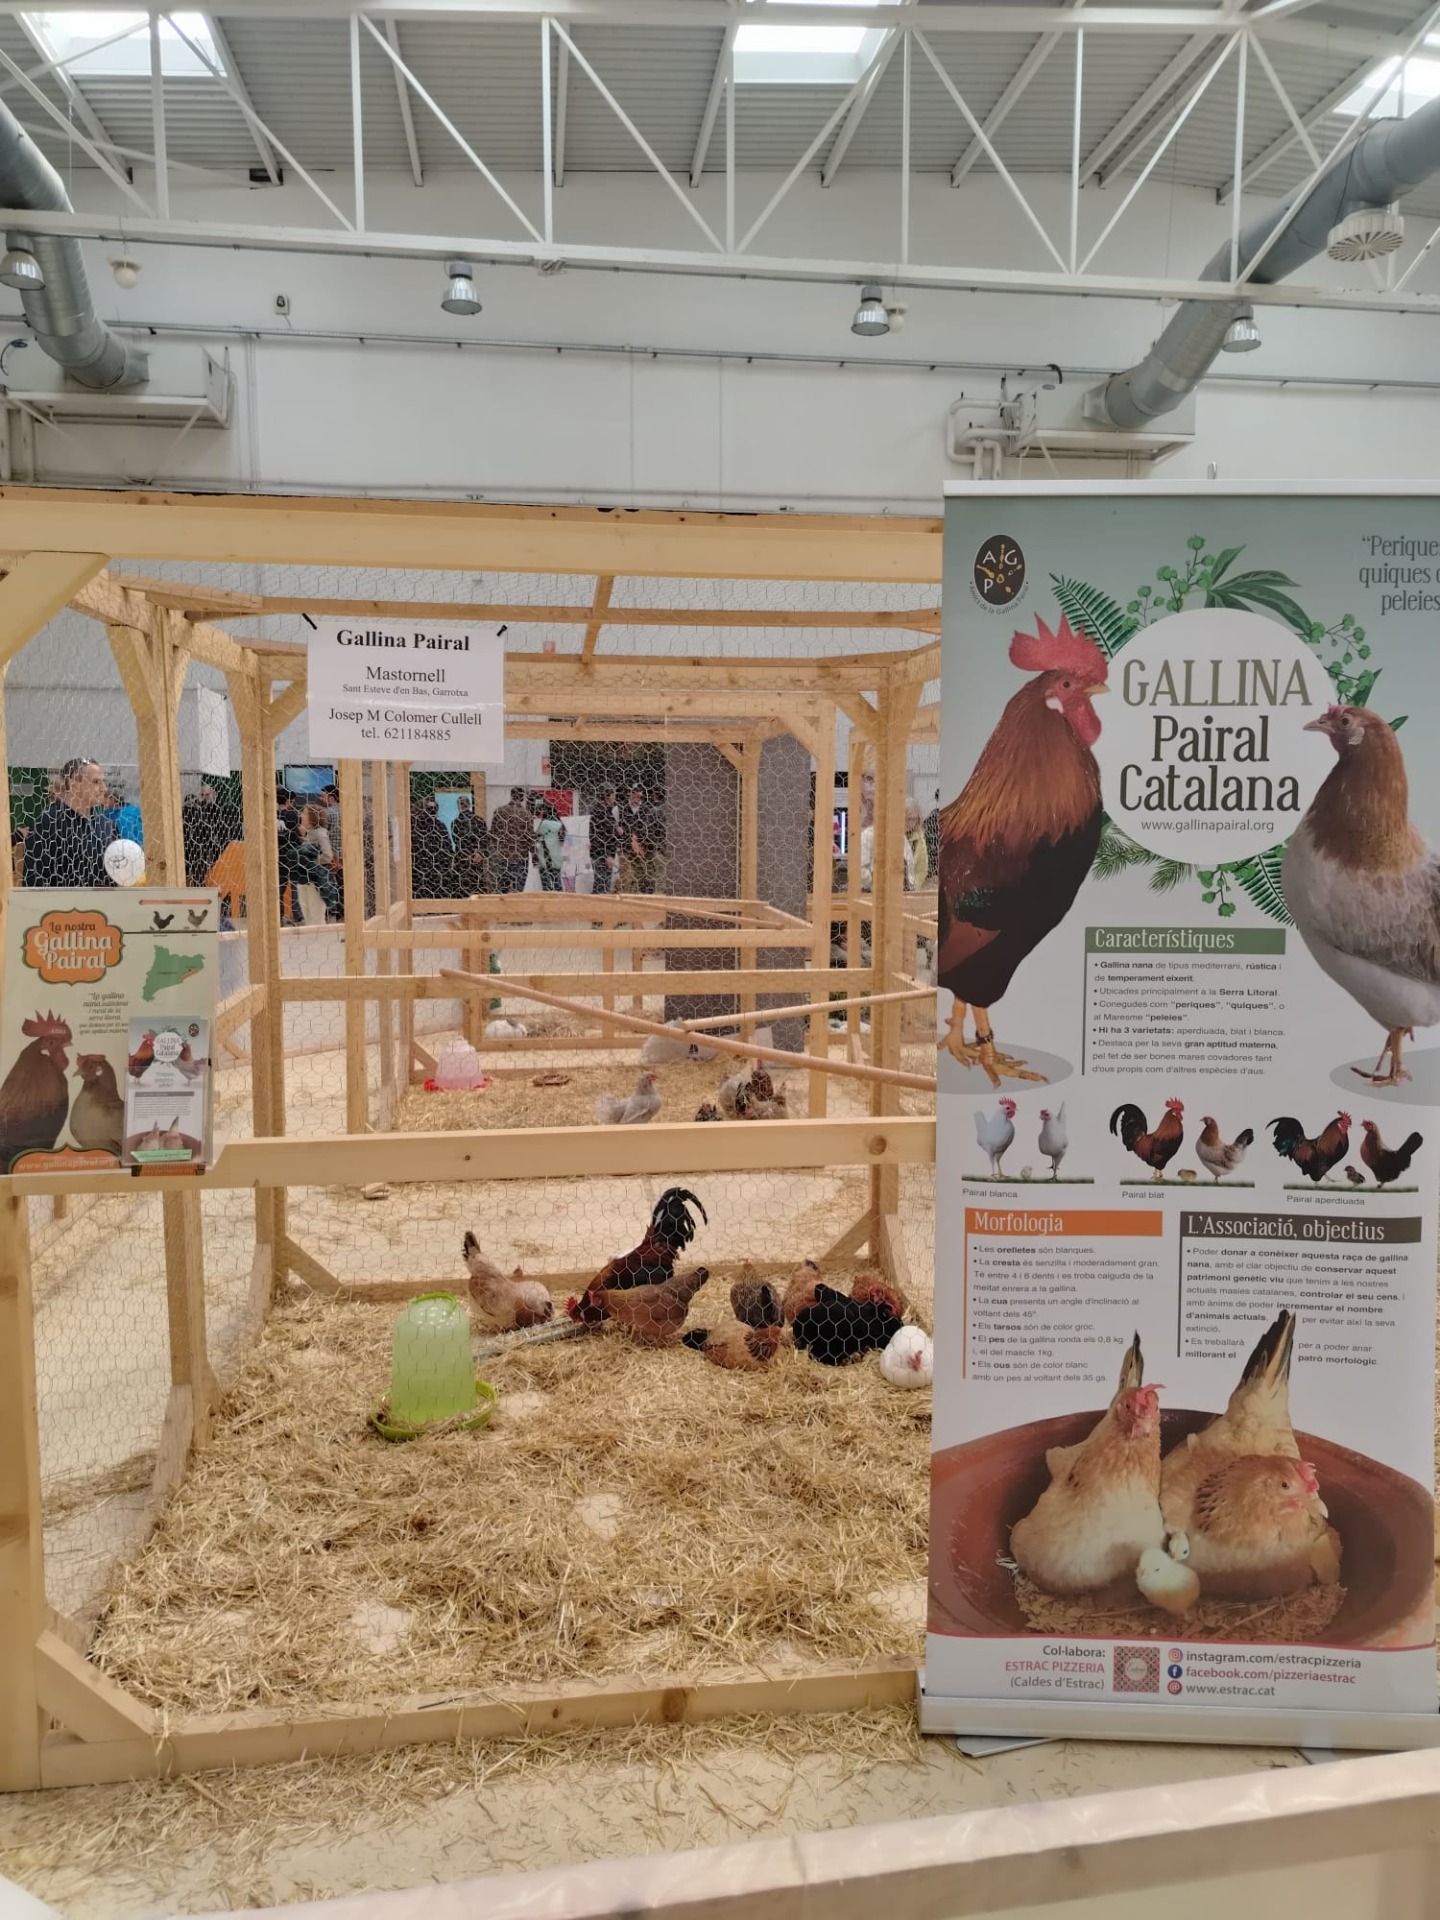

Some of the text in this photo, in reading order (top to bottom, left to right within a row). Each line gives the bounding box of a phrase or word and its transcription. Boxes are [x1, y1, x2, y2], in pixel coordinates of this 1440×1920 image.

[1362, 536, 1440, 561] “Perique
[1359, 563, 1431, 588] quiques
[337, 630, 469, 650] Gallina Pairal
[366, 666, 445, 683] Mastornell
[1123, 659, 1312, 707] GALLINA
[342, 684, 361, 693] Sant
[364, 685, 391, 694] Esteve
[413, 687, 430, 696] Bas,
[433, 688, 468, 696] Garrotxa
[329, 708, 482, 725] Josep M Colomer Cullell
[362, 728, 451, 741] tel. 621184885
[1152, 715, 1269, 762] Pairal
[1119, 764, 1300, 811] Catalana
[1140, 818, 1274, 834] www.gallinapairal.org
[50, 922, 96, 934] La nostra
[34, 931, 112, 956] Gallina
[1096, 929, 1235, 952] Característiques
[42, 951, 106, 970] Pairal
[1108, 975, 1164, 983] temperament
[1141, 988, 1198, 997] principalment
[1100, 1001, 1147, 1010] Conegudes
[1207, 1040, 1237, 1050] aptitud
[1208, 1054, 1252, 1062] covadores
[962, 1187, 1019, 1199] Pairal blanca
[1122, 1190, 1164, 1199] Pairal blat
[1287, 1194, 1365, 1207] Pairal aperdiuada
[974, 1211, 1063, 1236] Morfologia
[1188, 1215, 1385, 1241] L'Associació, objectius
[997, 1246, 1036, 1254] orelletes
[1193, 1248, 1408, 1263] Poder donar conèixer aquesta raça gallina
[1098, 1273, 1130, 1281] caiguda
[1315, 1265, 1362, 1274] conservar
[1365, 1267, 1396, 1276] aquest
[1187, 1274, 1231, 1282] patrimoni
[1300, 1290, 1343, 1299] controlar
[1010, 1298, 1045, 1307] presenta
[1277, 1302, 1333, 1312] incrementar
[1347, 1305, 1383, 1314] nombre
[1186, 1351, 1225, 1359] millorant
[1299, 1354, 1322, 1363] patró
[1187, 1650, 1361, 1669] instagram.com/estracpizzeria
[1005, 1660, 1105, 1673] ESTRAC PIZZERIA
[1186, 1666, 1355, 1684] facebook.com/pizzeriaestrac
[1010, 1676, 1051, 1689] (Caldes
[1186, 1683, 1275, 1696] www.estrac.cat
